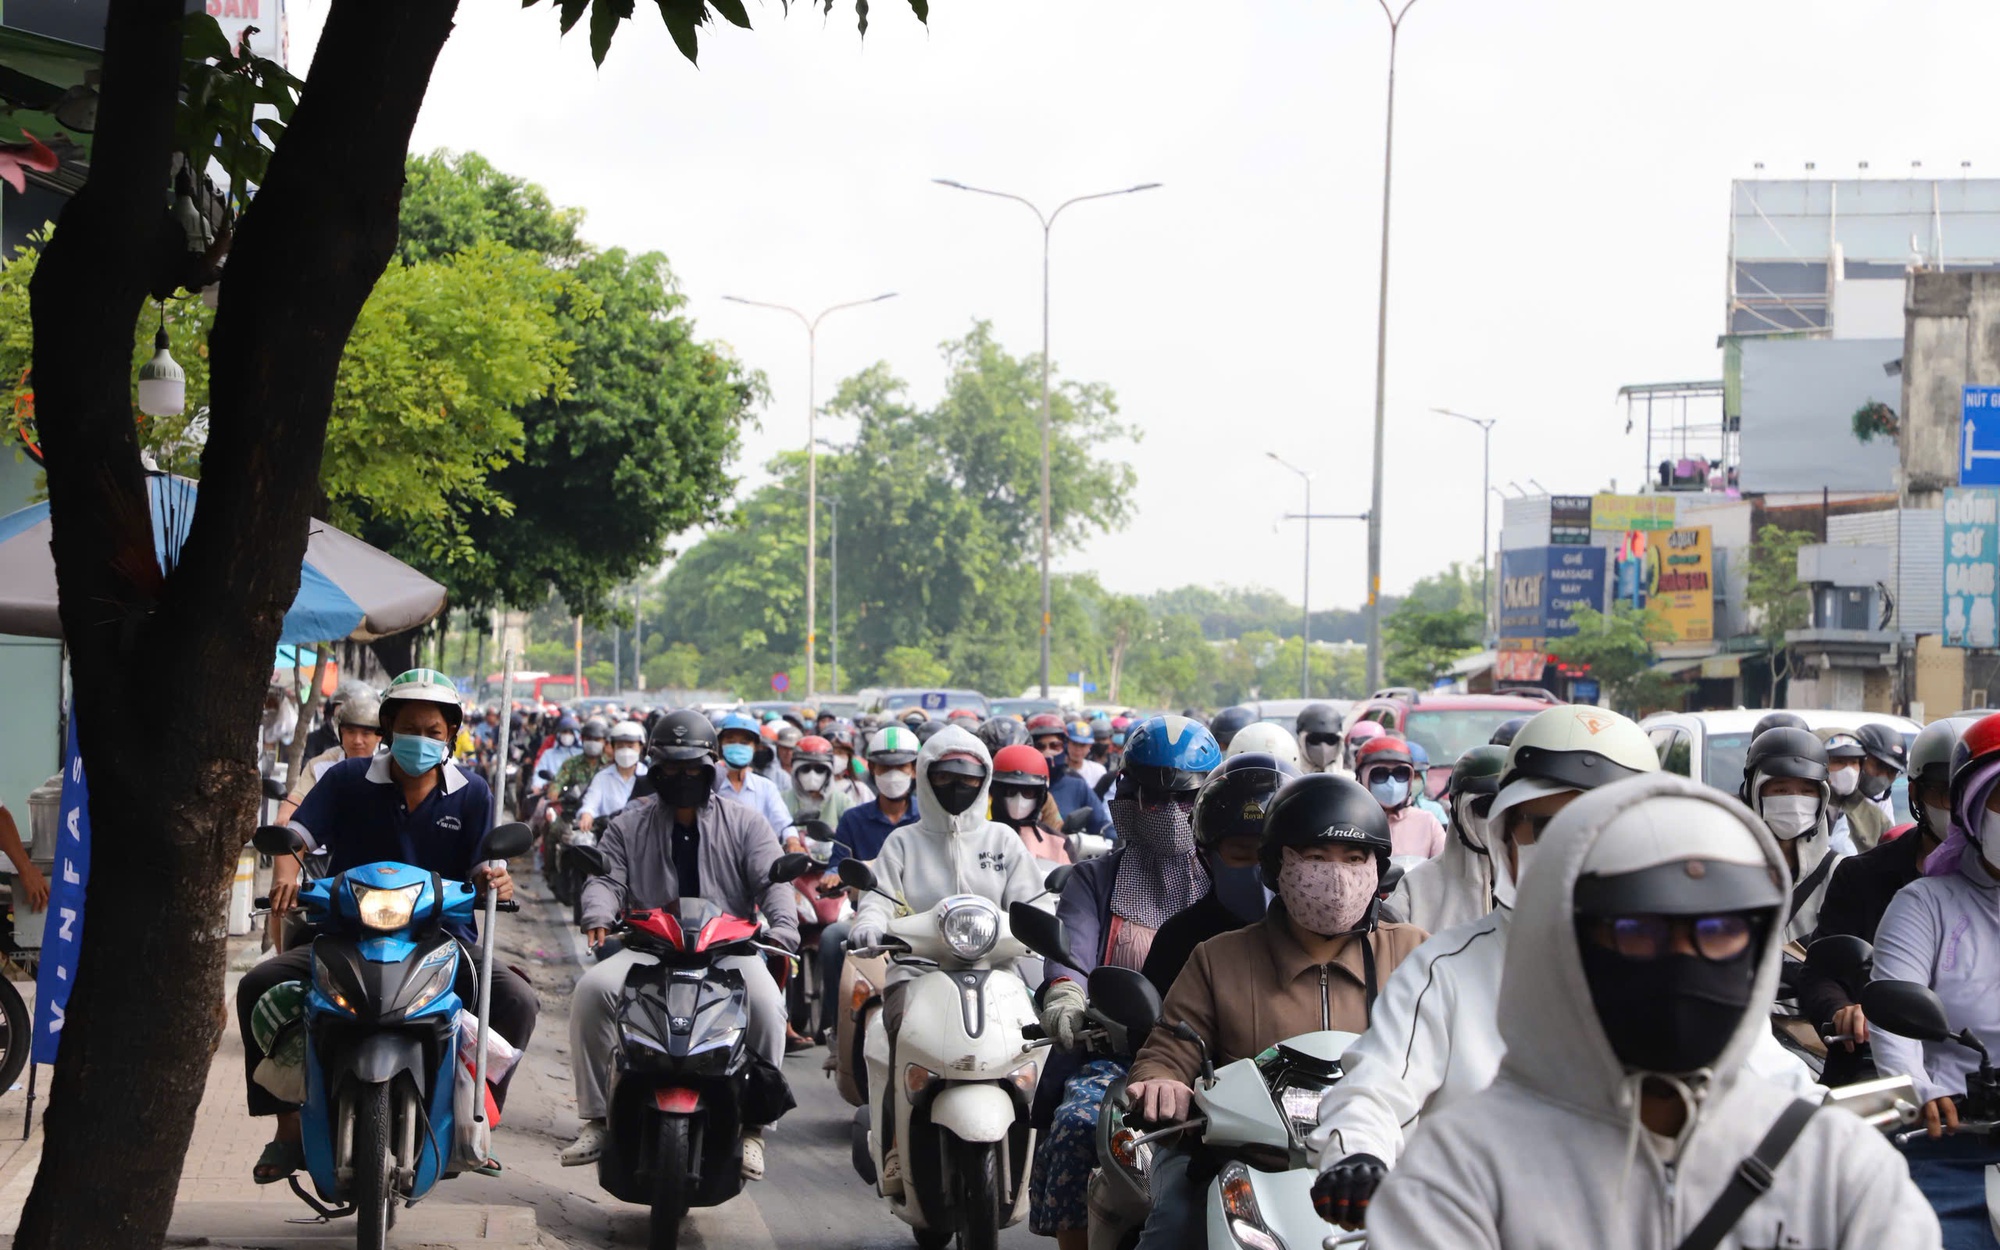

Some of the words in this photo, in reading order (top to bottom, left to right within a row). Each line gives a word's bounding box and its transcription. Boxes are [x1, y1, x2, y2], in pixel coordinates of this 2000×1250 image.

[1966, 389, 1987, 408] NÚT
[1551, 569, 1594, 580] MASSAGE
[1243, 811, 1264, 820] Royal
[1318, 825, 1366, 839] Andes
